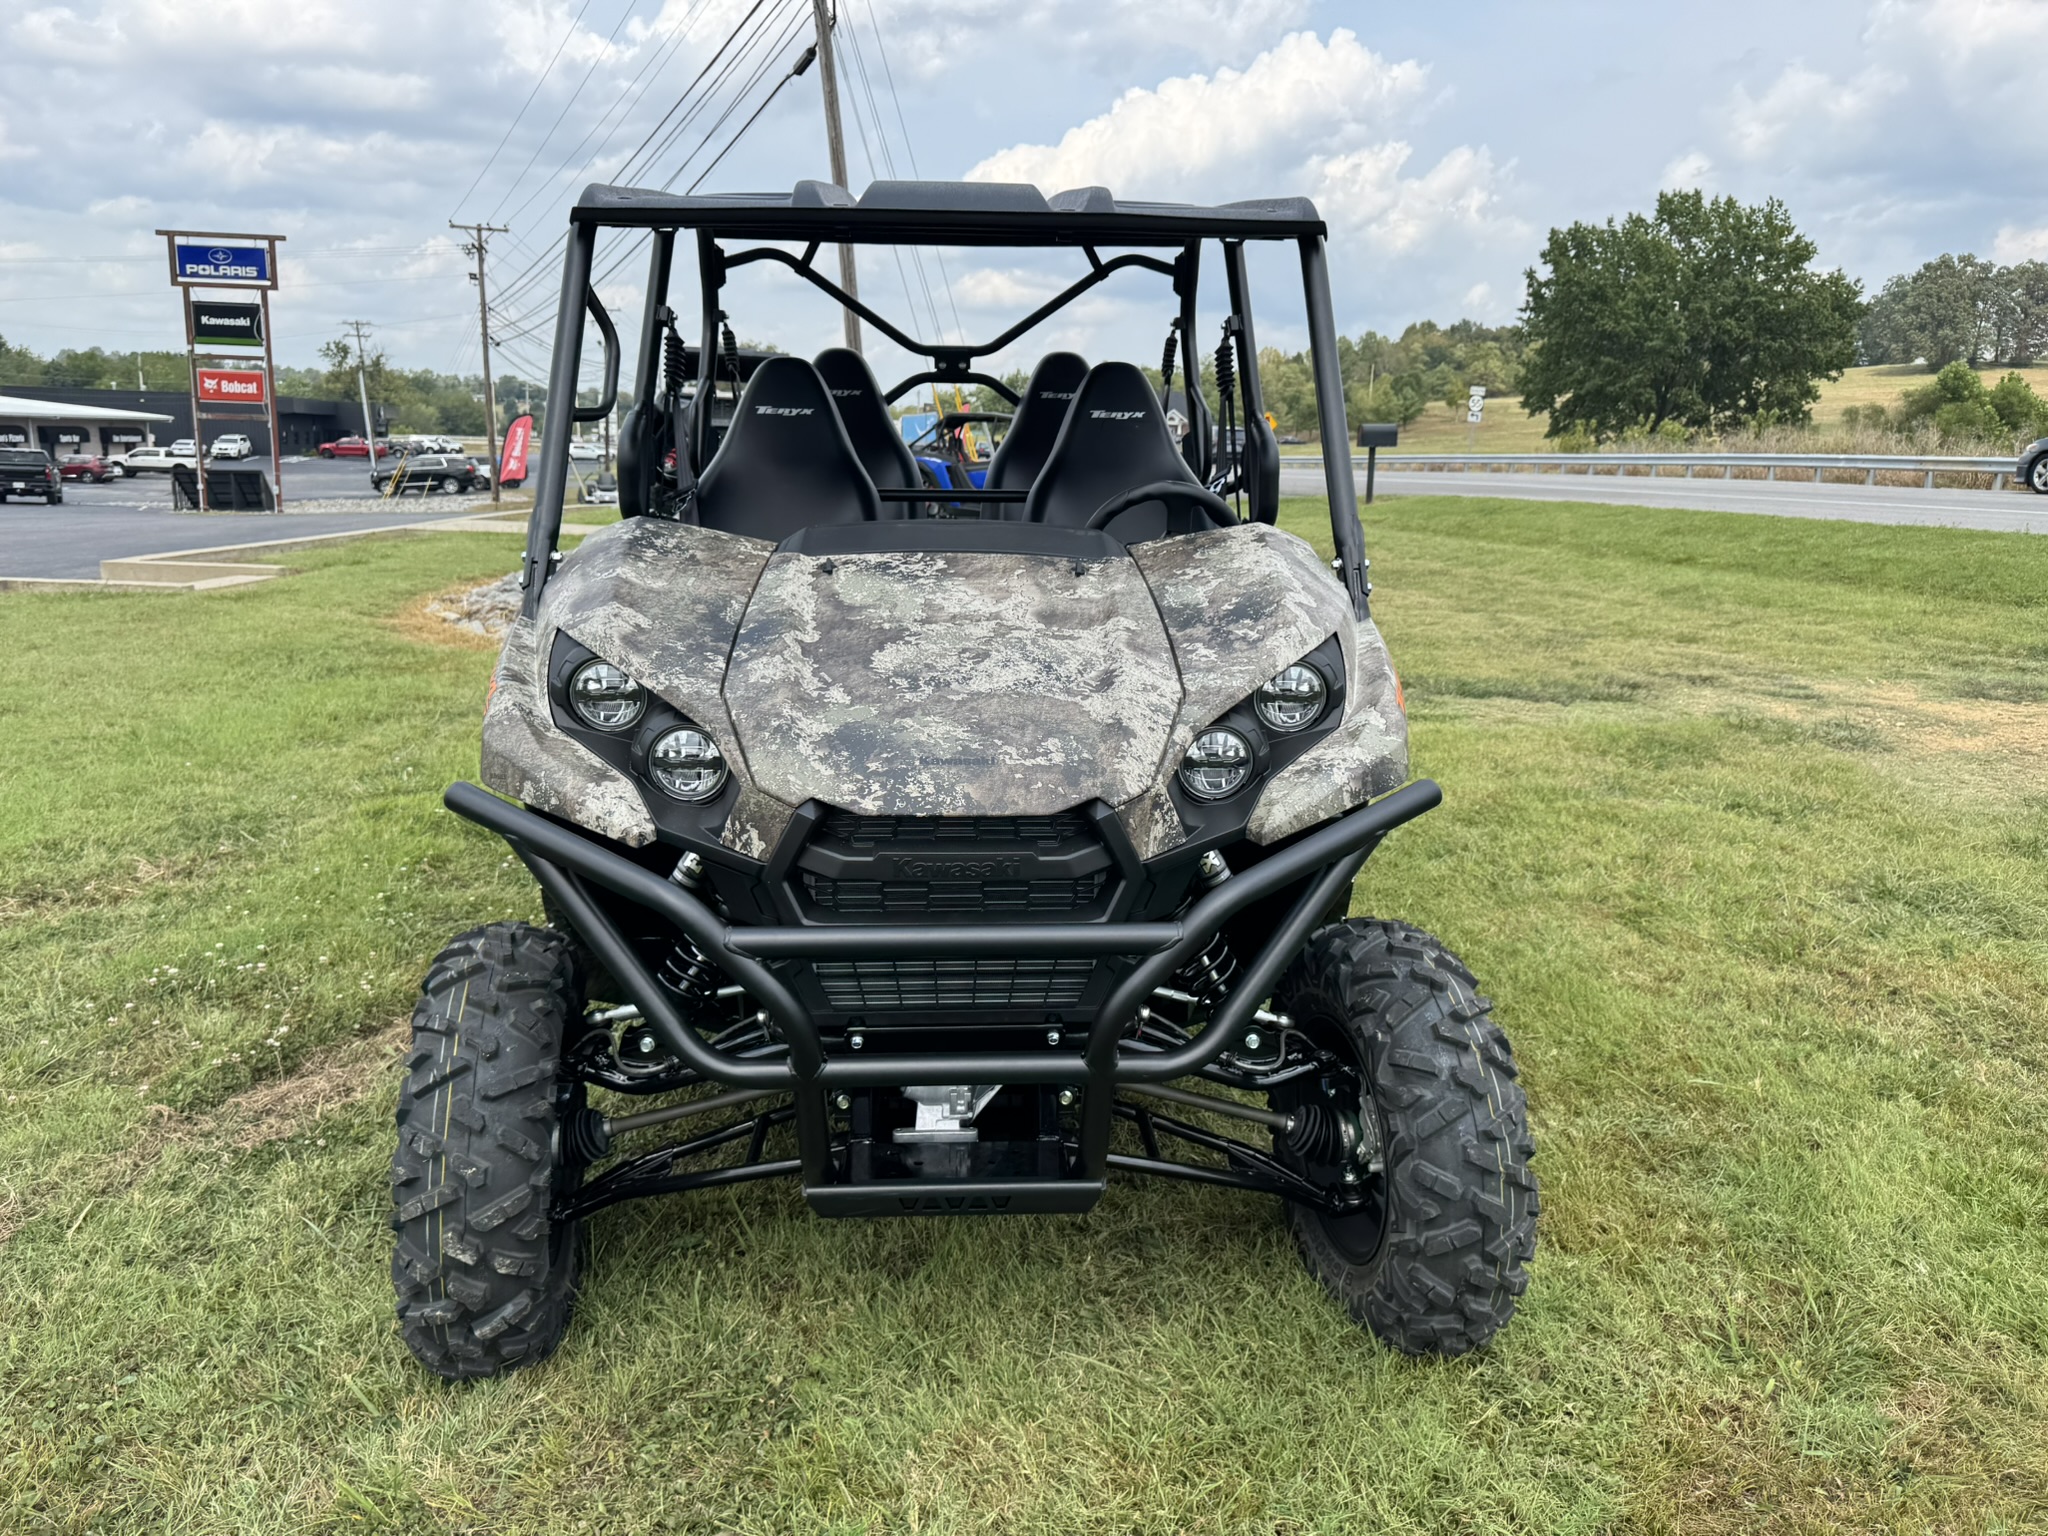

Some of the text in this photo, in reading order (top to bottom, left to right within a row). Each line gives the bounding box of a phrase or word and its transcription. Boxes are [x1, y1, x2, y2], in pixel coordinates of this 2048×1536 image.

[185, 264, 258, 277] POLARIS
[201, 315, 250, 327] Kawasaki
[221, 380, 257, 394] Bobcat
[919, 755, 996, 766] Kawasaki
[892, 857, 1022, 879] Kawasaki
